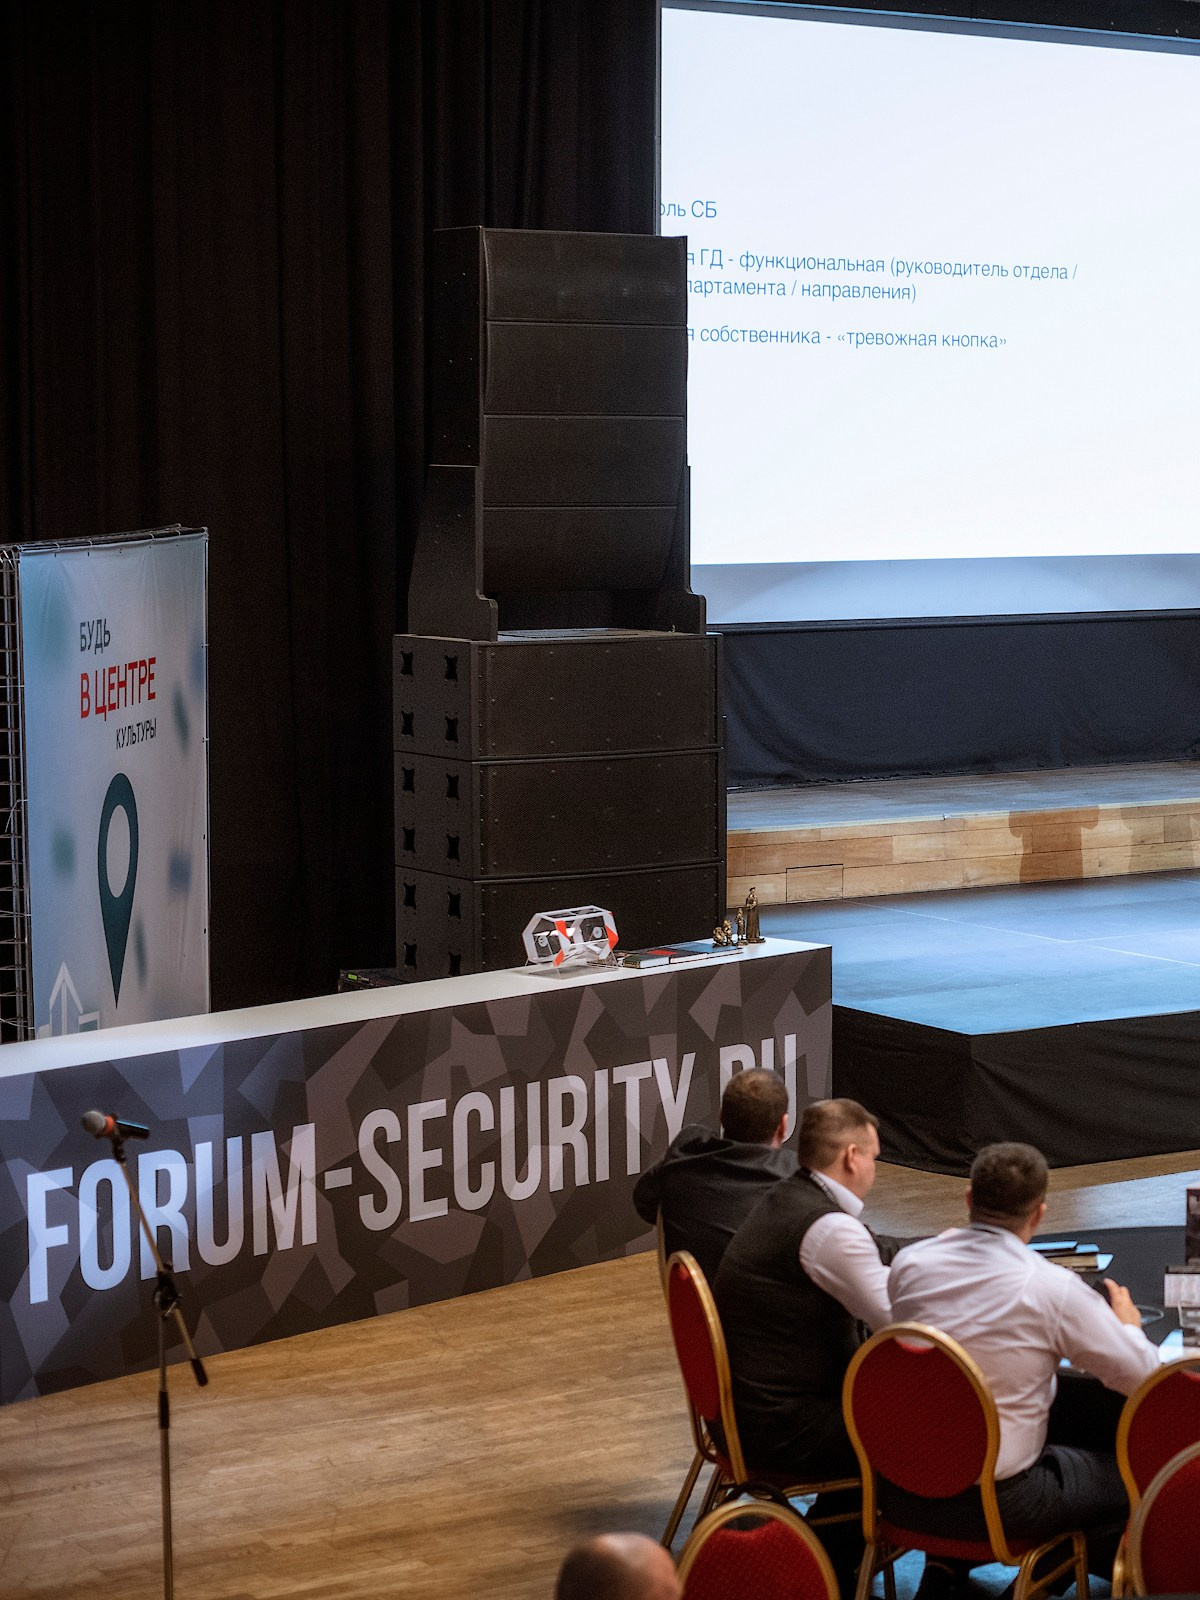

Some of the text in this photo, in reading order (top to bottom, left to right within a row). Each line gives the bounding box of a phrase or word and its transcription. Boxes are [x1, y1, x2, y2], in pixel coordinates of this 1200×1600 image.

[691, 200, 718, 219] СБ
[700, 249, 724, 270] ГД
[739, 250, 885, 273] функциональная
[890, 256, 1009, 279] (руководитель
[1013, 265, 1069, 281] отдела
[801, 283, 917, 304] направления)
[699, 325, 821, 344] собственника
[837, 332, 937, 349] «тревожная
[941, 335, 1007, 349] кнопка»
[79, 618, 111, 655] БУДЬ
[80, 656, 157, 722] В ЦЕНТРЕ
[115, 717, 157, 750] КУЛЬТУРЫ
